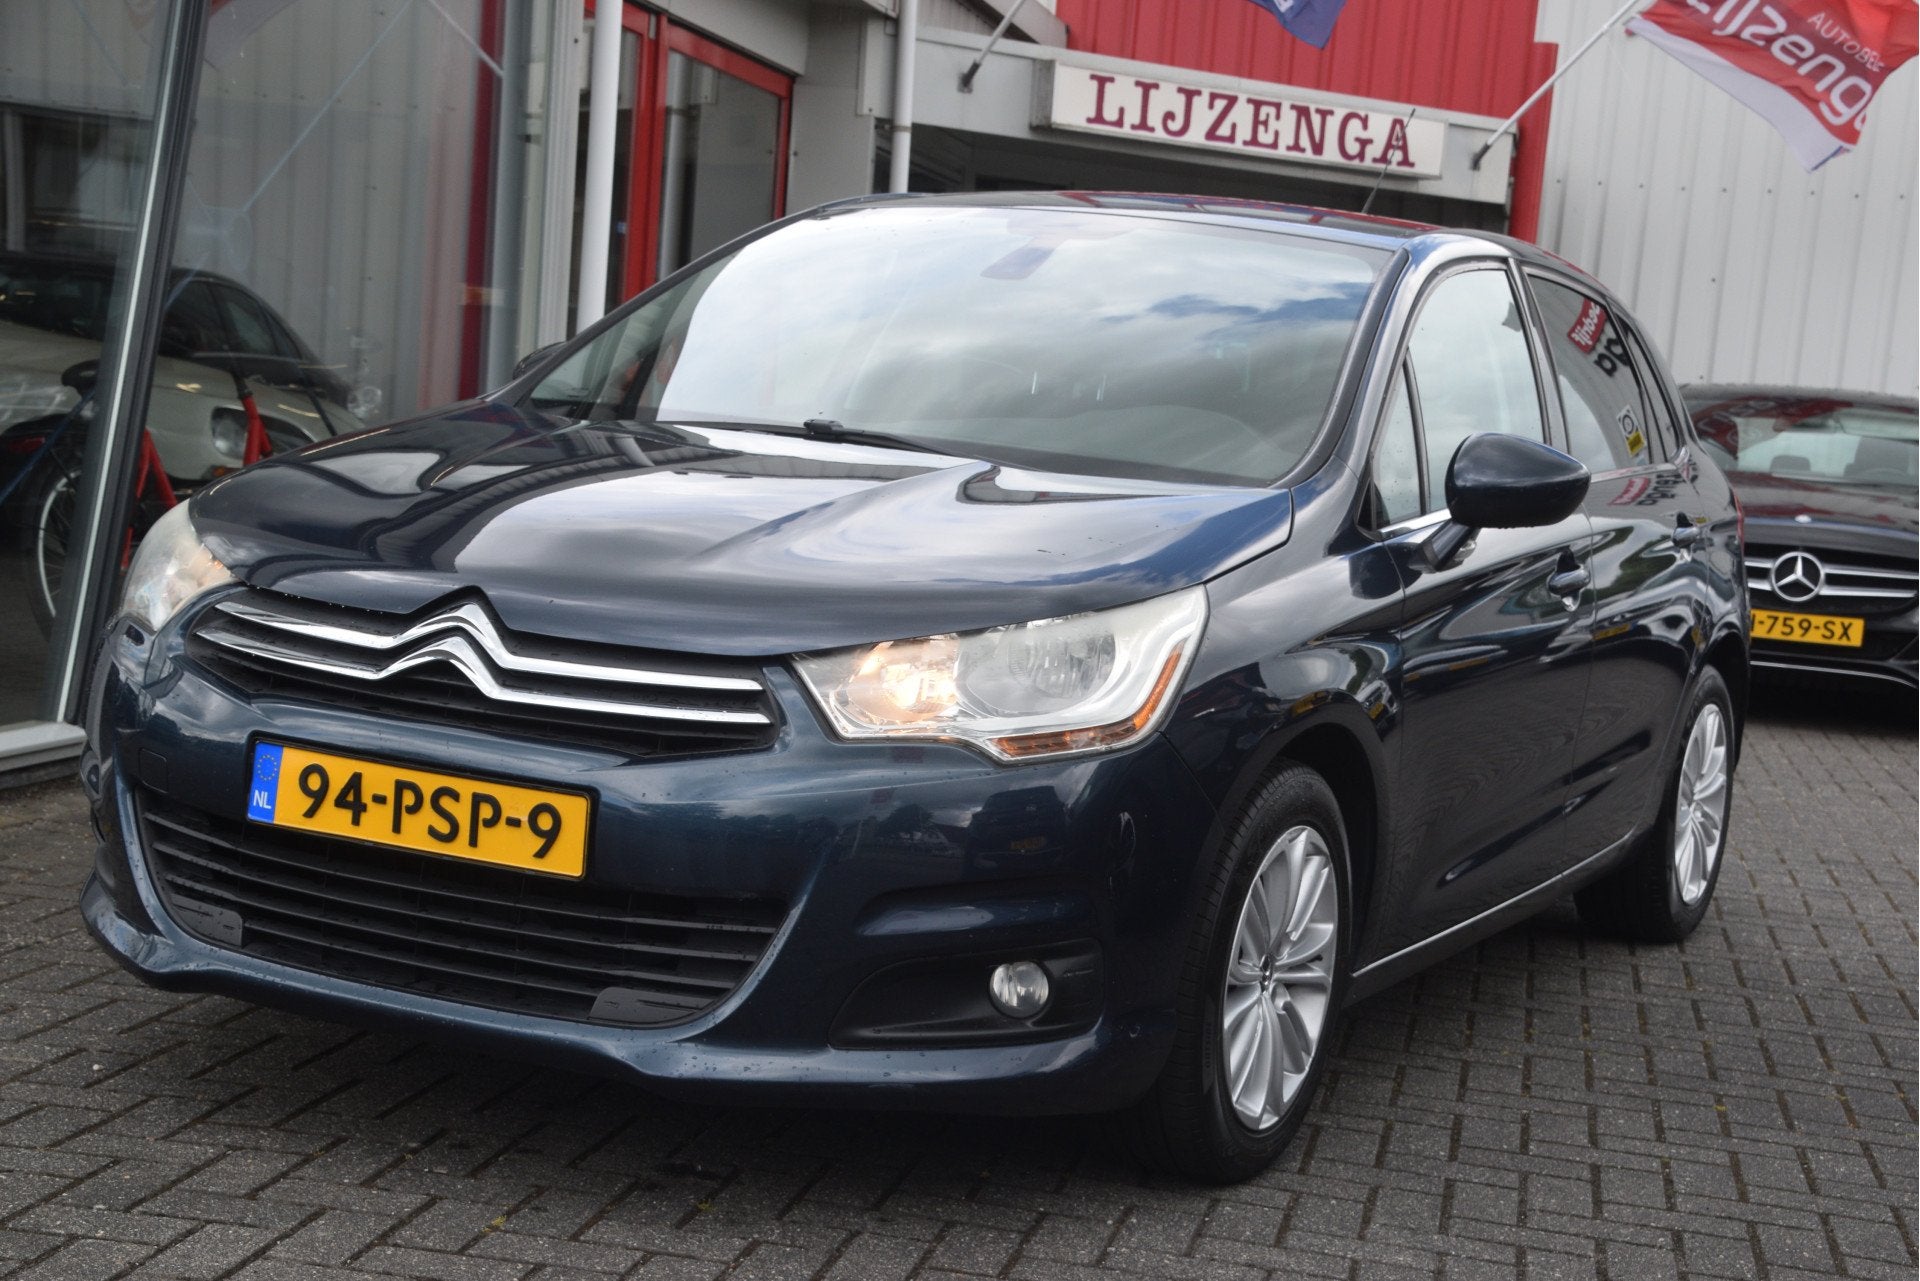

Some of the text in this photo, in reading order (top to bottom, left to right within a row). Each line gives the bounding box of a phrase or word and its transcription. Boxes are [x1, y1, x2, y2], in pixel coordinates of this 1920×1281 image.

[1086, 73, 1416, 168] LIJZENGA
[253, 789, 271, 809] NL
[298, 763, 562, 859] 94-PSP-9
